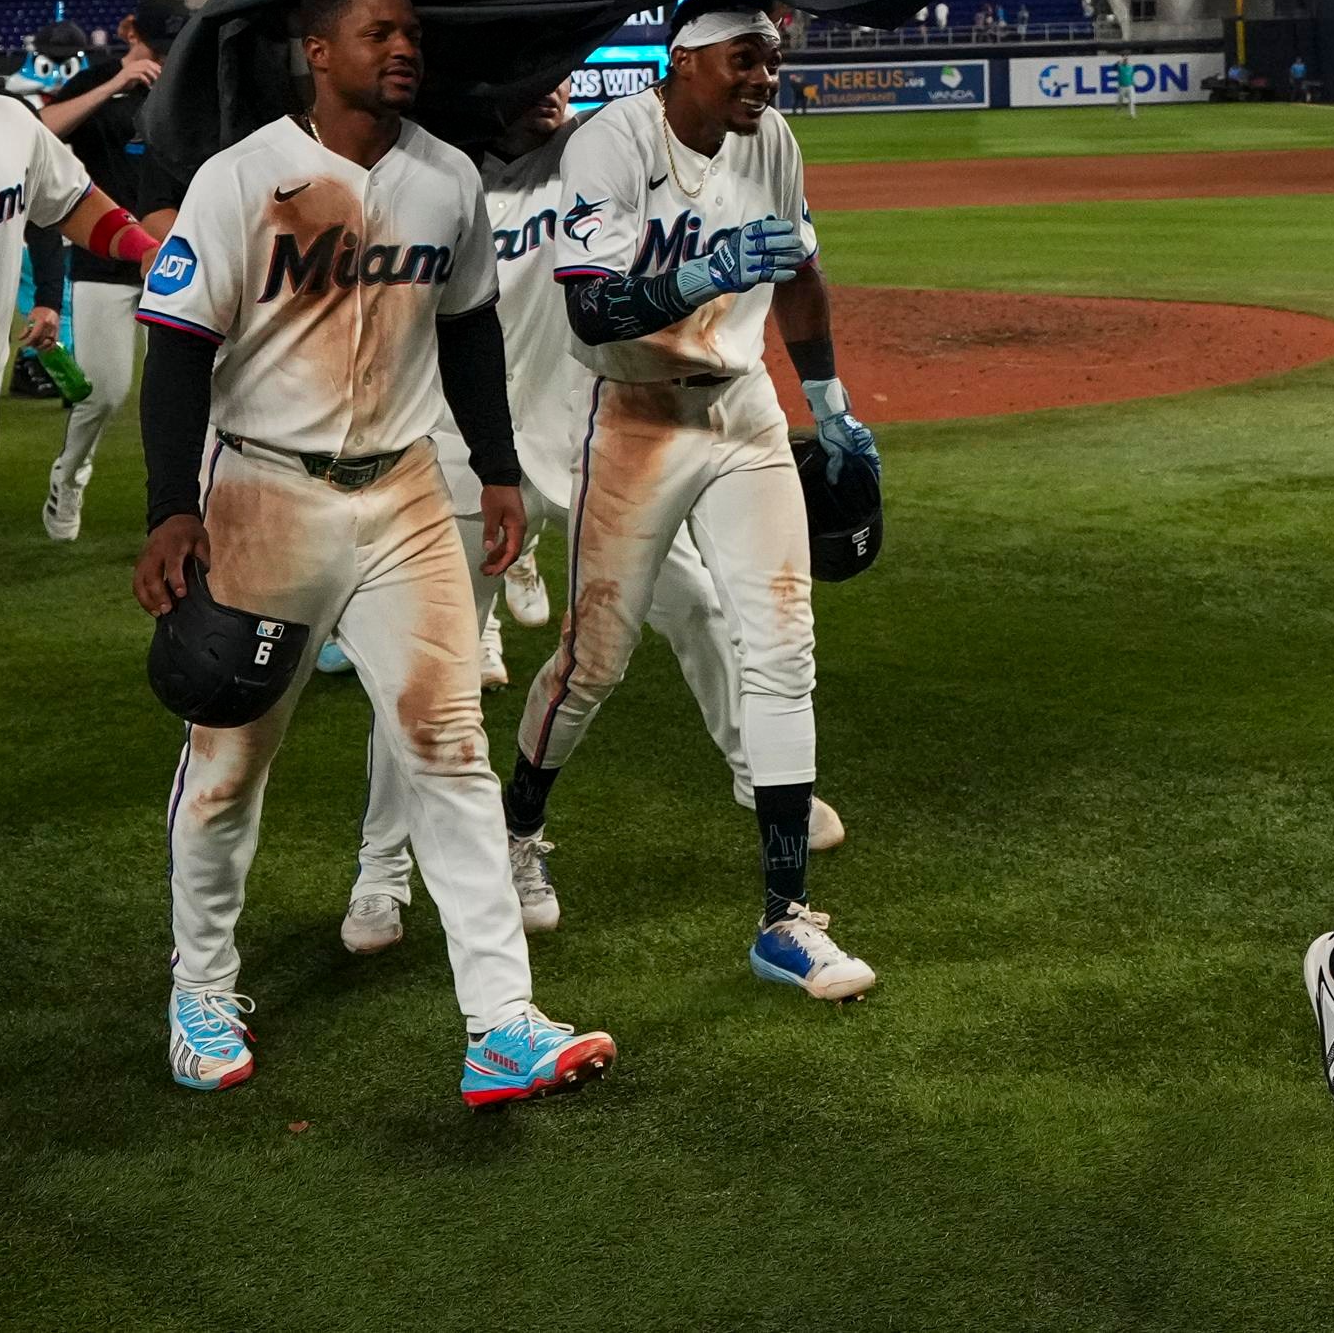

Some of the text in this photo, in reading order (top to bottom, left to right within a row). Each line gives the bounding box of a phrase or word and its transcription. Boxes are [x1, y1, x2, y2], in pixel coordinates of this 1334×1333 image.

[1075, 63, 1189, 95] LEON
[927, 89, 976, 100] VANDA
[153, 254, 193, 281] ADT
